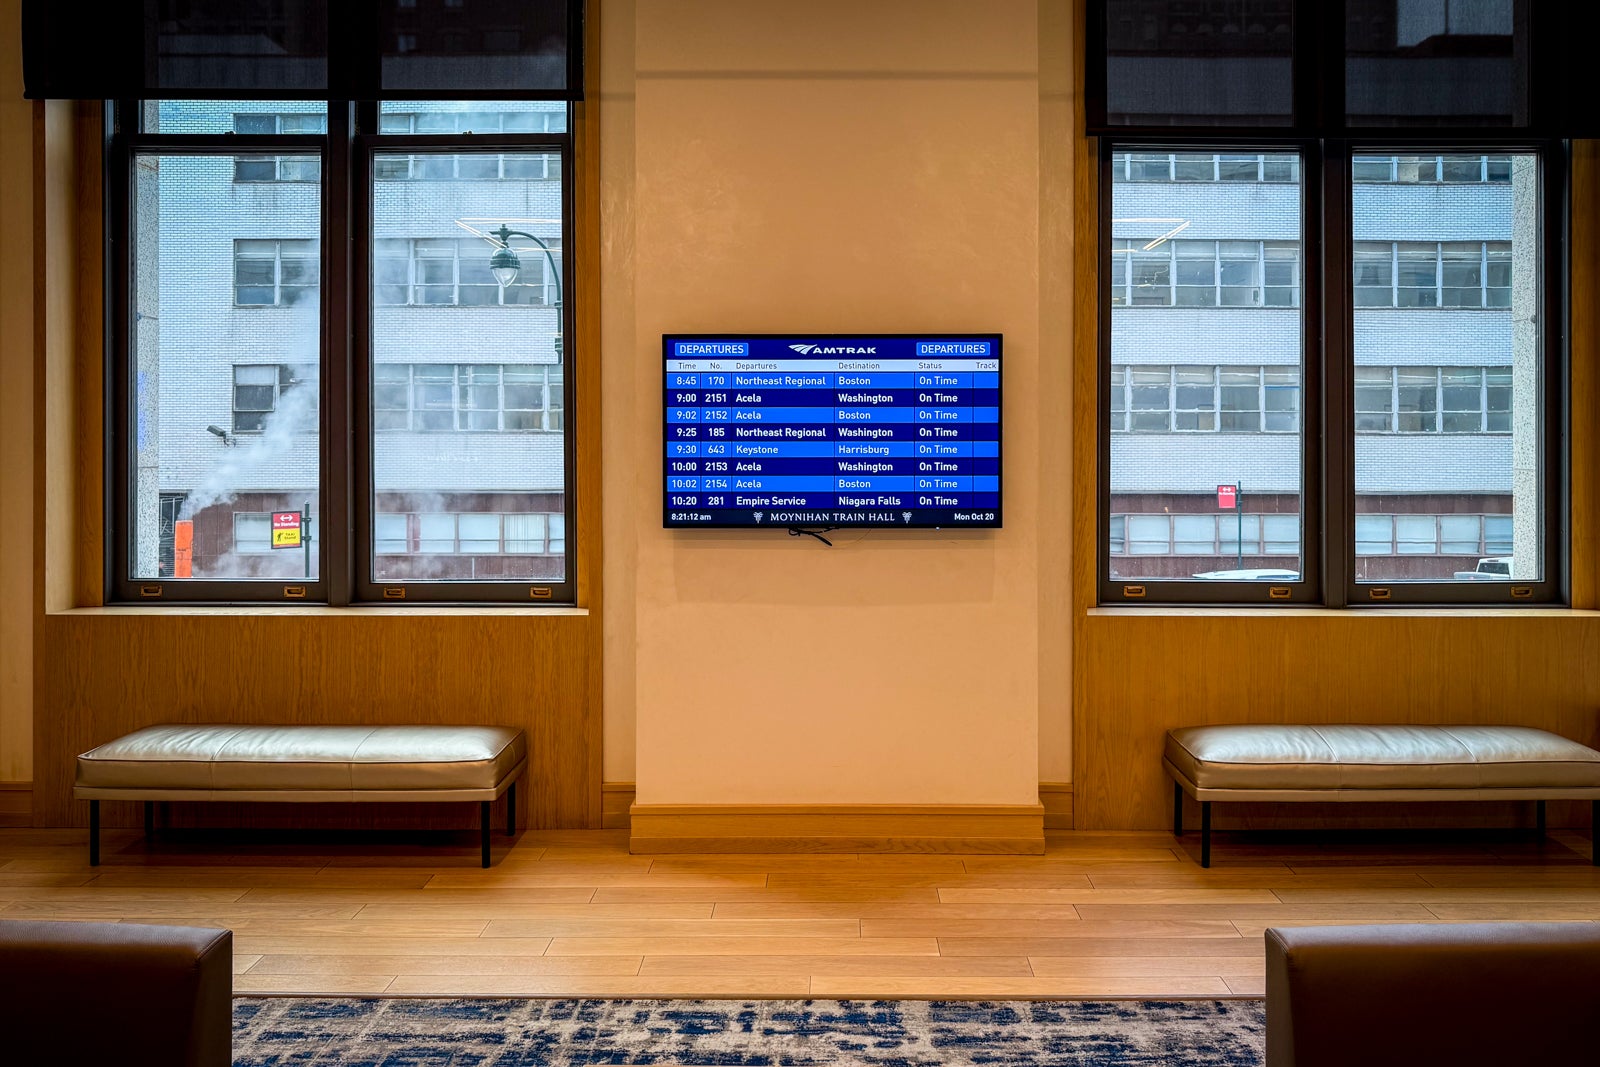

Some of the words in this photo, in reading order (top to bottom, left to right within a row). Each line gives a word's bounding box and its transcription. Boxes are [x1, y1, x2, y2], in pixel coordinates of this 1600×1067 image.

[679, 344, 744, 354] DEPARTURES
[921, 344, 986, 354] DEPARTURES
[736, 362, 777, 370] Departures
[676, 376, 697, 386] 8:45
[708, 376, 725, 386] 170
[736, 376, 783, 386] Northeast
[785, 376, 826, 387] Regional
[838, 376, 871, 386] Boston
[919, 376, 932, 386] On
[934, 376, 958, 386] Time
[676, 394, 697, 403] 9:00
[705, 394, 728, 403] 2151
[736, 393, 762, 403] Acela
[838, 393, 893, 404] Washington
[919, 394, 932, 403] On
[934, 394, 958, 403] Time
[676, 411, 697, 420] 9:02
[705, 411, 728, 420] 2152
[736, 410, 762, 420] Acela
[838, 410, 871, 420] Boston
[919, 411, 932, 420] On
[934, 411, 958, 420] Time
[676, 428, 697, 437] 9:25
[708, 428, 725, 437] 185
[736, 428, 783, 437] Northeast
[785, 428, 826, 438] Regional
[838, 428, 893, 438] Washington
[919, 428, 932, 437] On
[934, 428, 958, 437] Time
[676, 445, 697, 454] 9:30
[708, 445, 725, 454] 643
[736, 445, 778, 455] Keystone
[838, 445, 890, 455] Harrisburg
[919, 445, 932, 454] On
[934, 445, 958, 454] Time
[672, 462, 697, 472] 10:00
[705, 462, 728, 472] 2153
[736, 462, 762, 472] Acela
[838, 462, 893, 472] Washington
[919, 462, 932, 472] On
[934, 462, 958, 472] Time
[672, 479, 697, 489] 10:02
[705, 479, 728, 489] 2154
[736, 479, 762, 489] Acela
[838, 479, 871, 489] Boston
[919, 479, 932, 489] On
[934, 479, 958, 489] Time
[672, 496, 697, 506] 10:20
[708, 496, 725, 506] 281
[736, 496, 769, 507] Empire
[772, 496, 806, 506] Service
[838, 496, 875, 507] Niagara
[878, 496, 901, 506] Falls
[919, 496, 932, 506] On
[934, 496, 958, 506] Time
[770, 512, 829, 522] MOYNIHAN
[832, 512, 865, 522] TRAIN
[868, 512, 895, 522] HALL
[954, 513, 969, 521] Mon
[971, 513, 983, 521] Oct
[983, 513, 994, 521] 20
